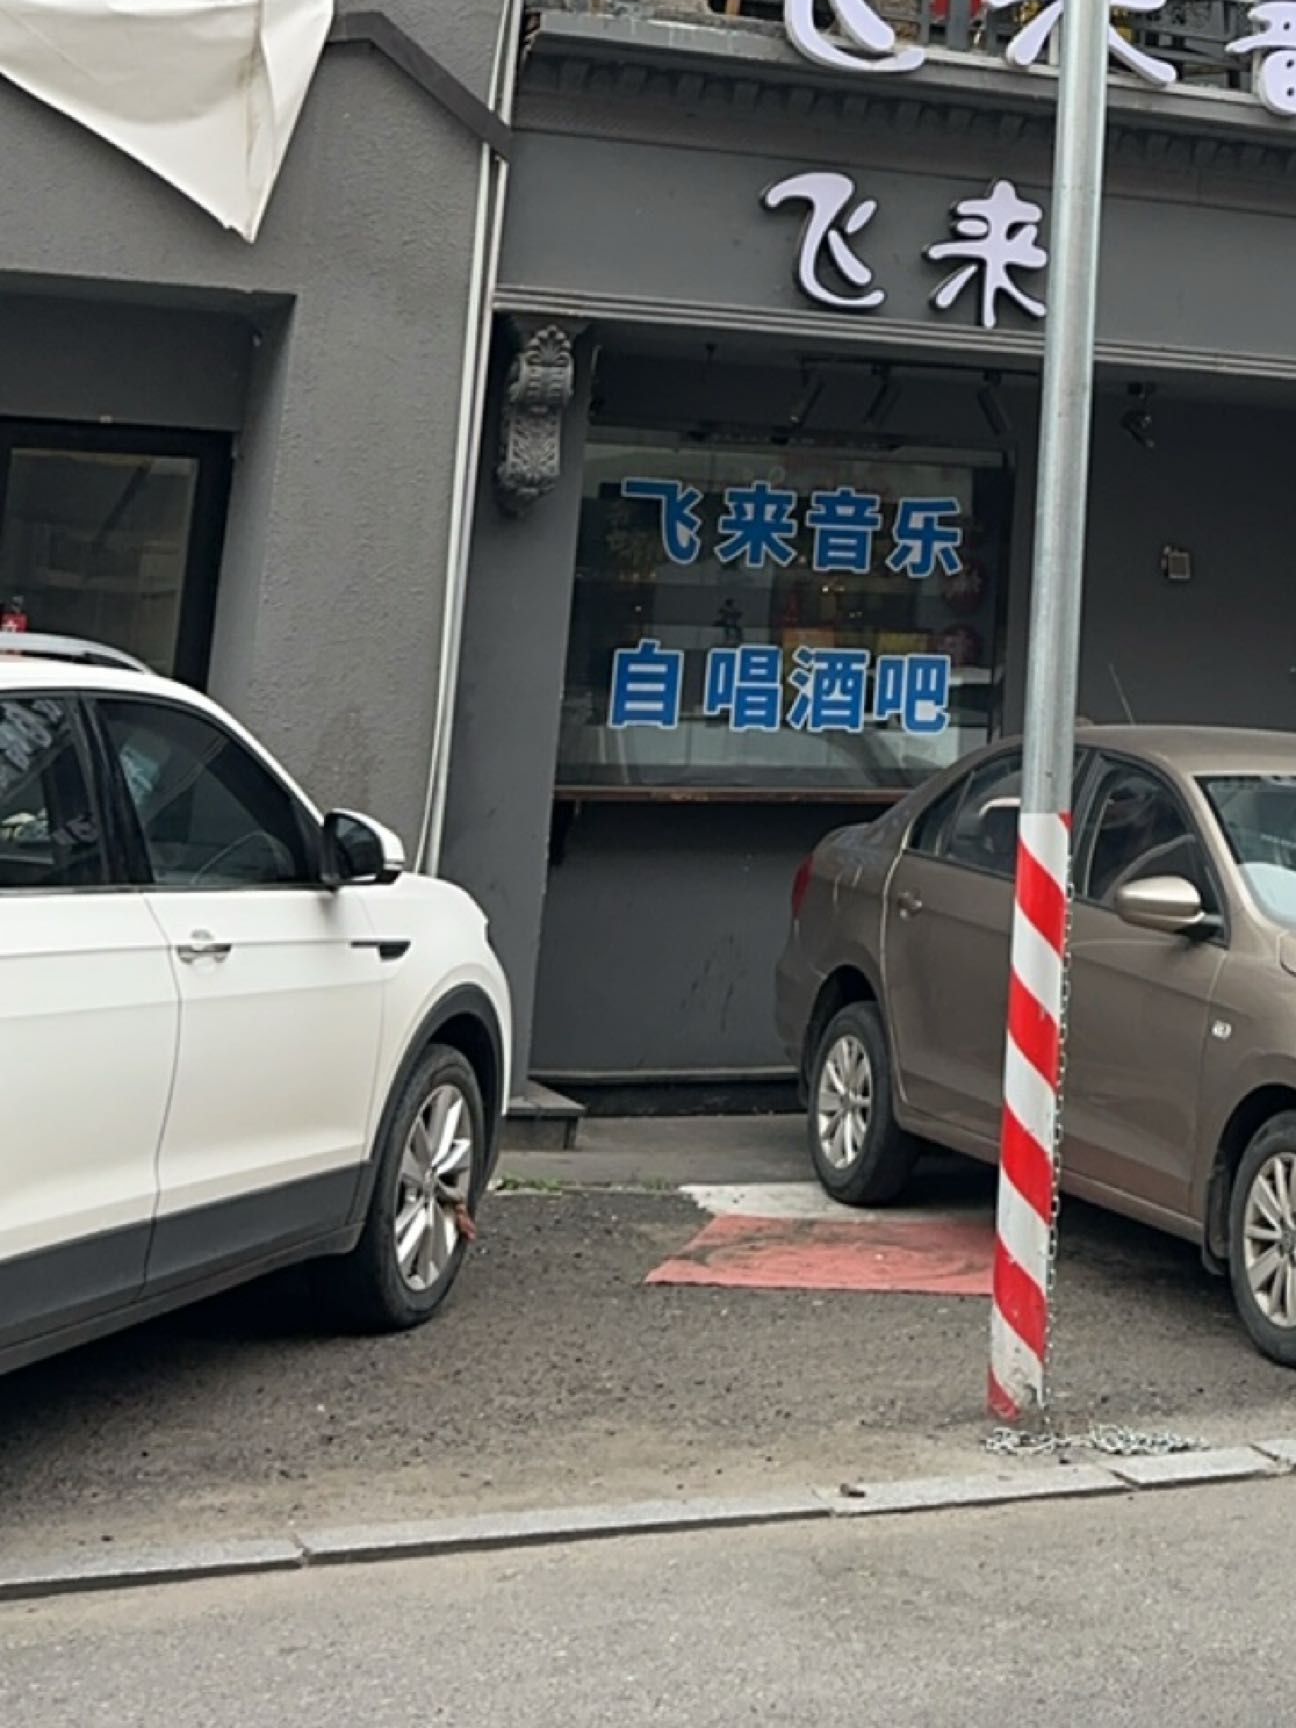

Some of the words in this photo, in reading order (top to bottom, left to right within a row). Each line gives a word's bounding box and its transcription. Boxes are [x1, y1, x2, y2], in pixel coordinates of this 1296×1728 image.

[764, 173, 1049, 328] 飞来
[621, 476, 963, 578] 飞来音乐
[607, 638, 952, 735] 自唱酒吧
